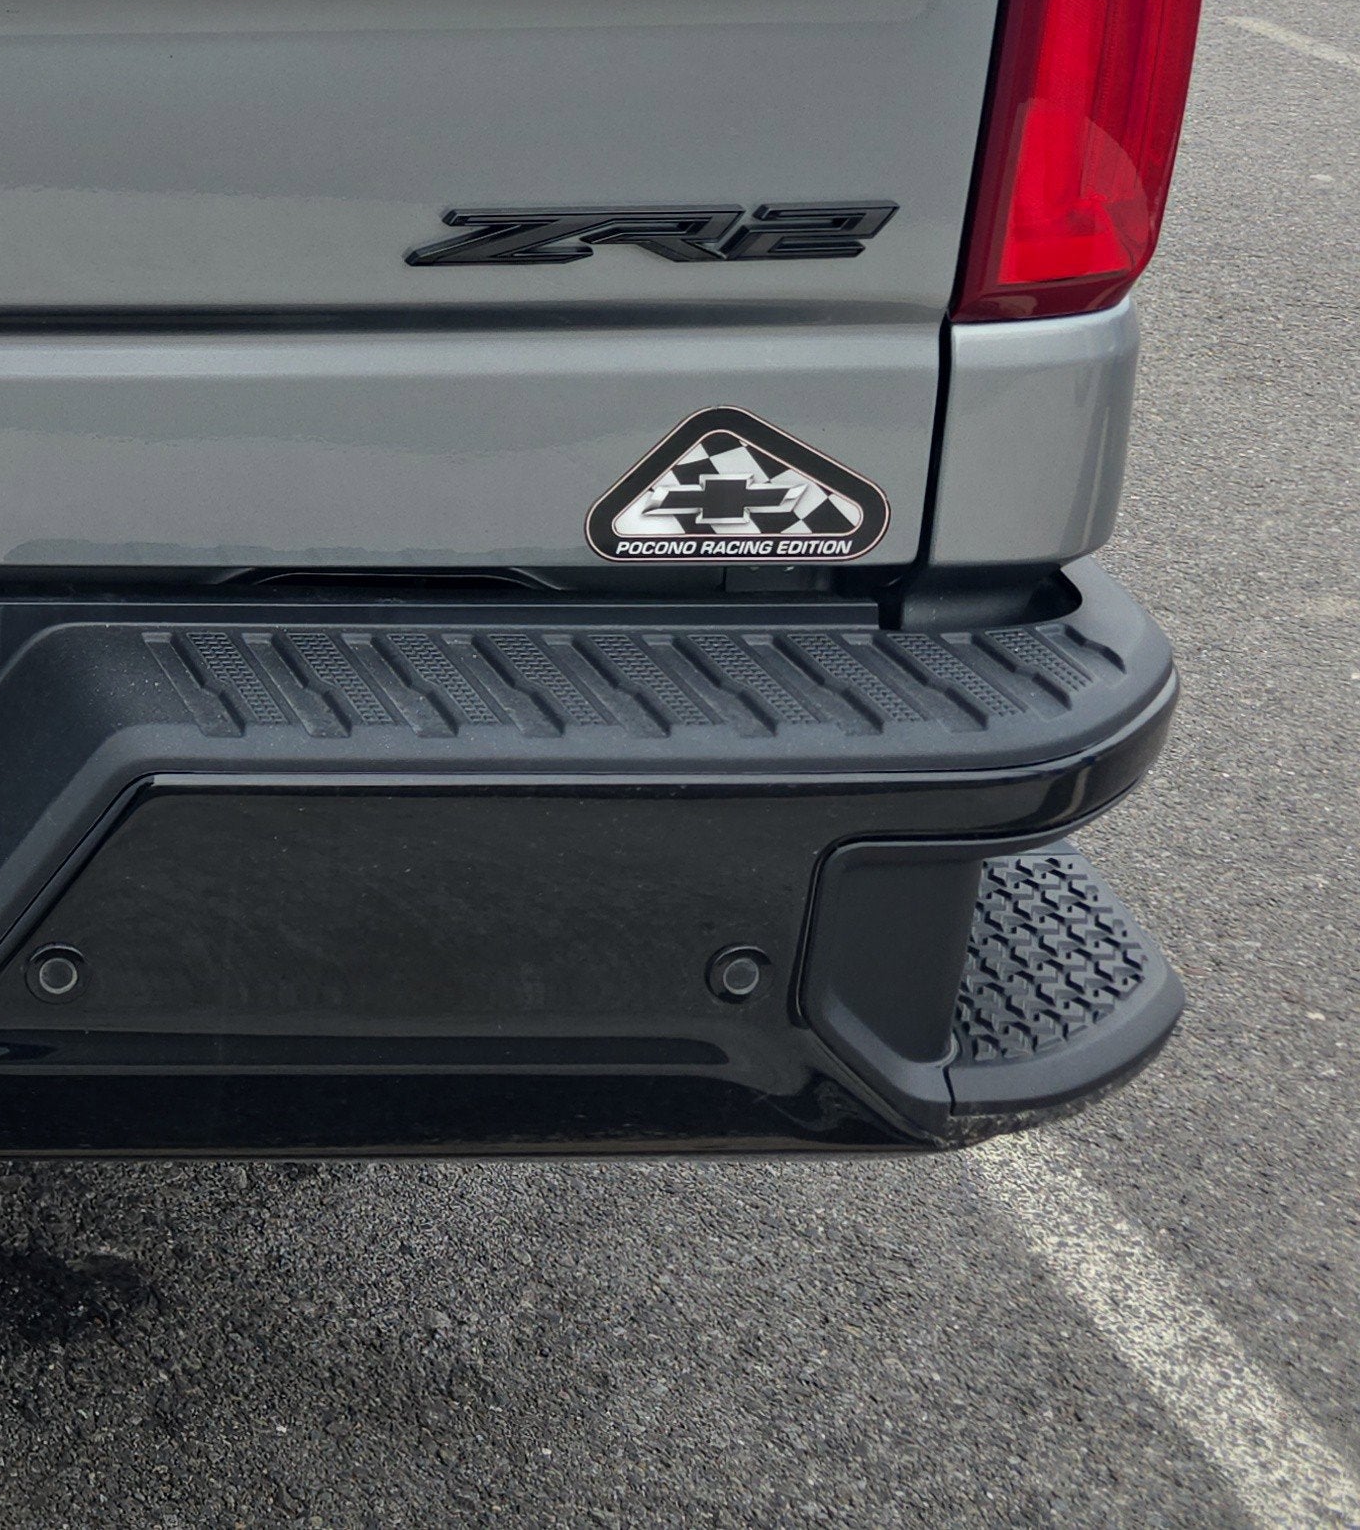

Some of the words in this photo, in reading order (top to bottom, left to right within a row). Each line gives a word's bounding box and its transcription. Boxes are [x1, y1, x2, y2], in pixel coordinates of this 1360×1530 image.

[405, 200, 900, 266] ZR2
[615, 540, 697, 555] POCONO
[700, 540, 772, 555] RACING
[776, 540, 853, 555] EDITION
